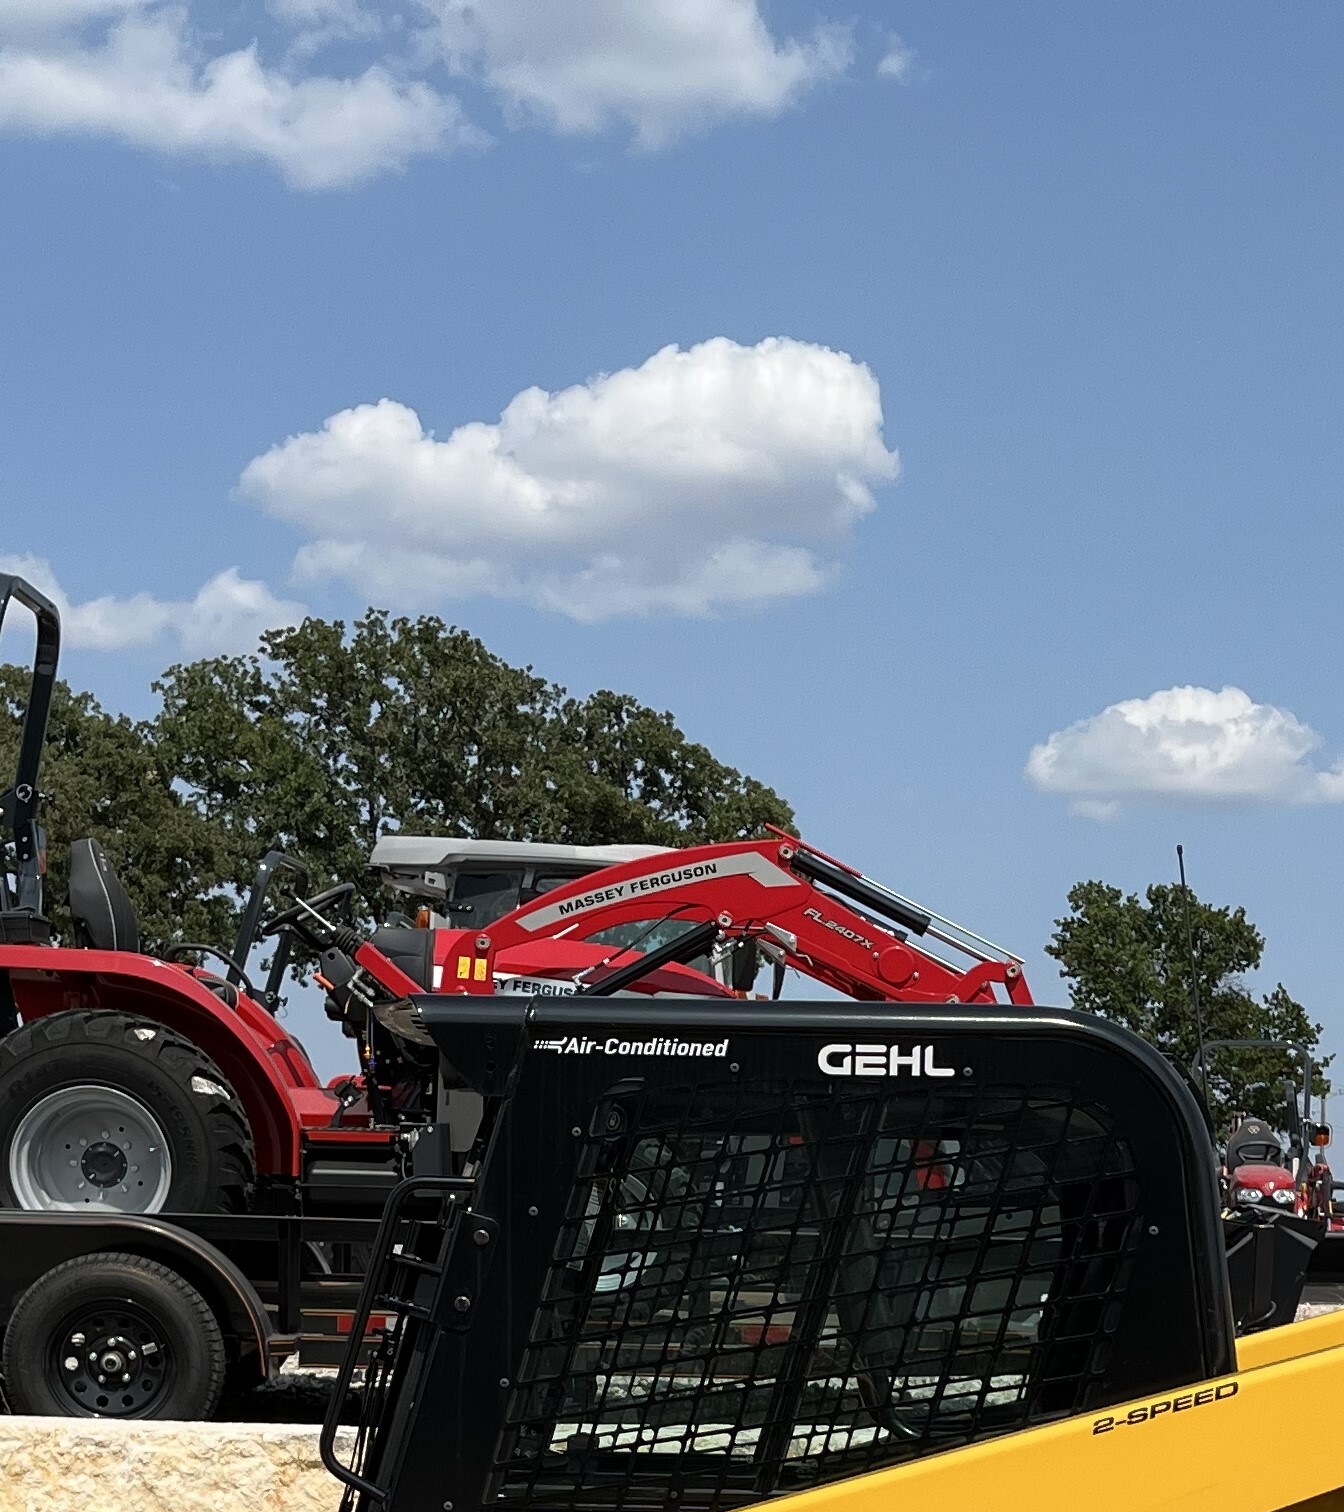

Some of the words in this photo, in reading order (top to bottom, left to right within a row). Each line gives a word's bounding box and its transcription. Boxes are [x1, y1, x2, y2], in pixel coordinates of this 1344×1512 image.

[558, 886, 624, 915] MASSEY
[630, 863, 717, 893] FERGUSON
[803, 907, 874, 949] FL2407X
[513, 980, 573, 996] FERGUS
[564, 1038, 729, 1058] Air-Conditioned
[818, 1044, 955, 1077] GEHL
[1093, 1382, 1239, 1435] 2-SPEED
